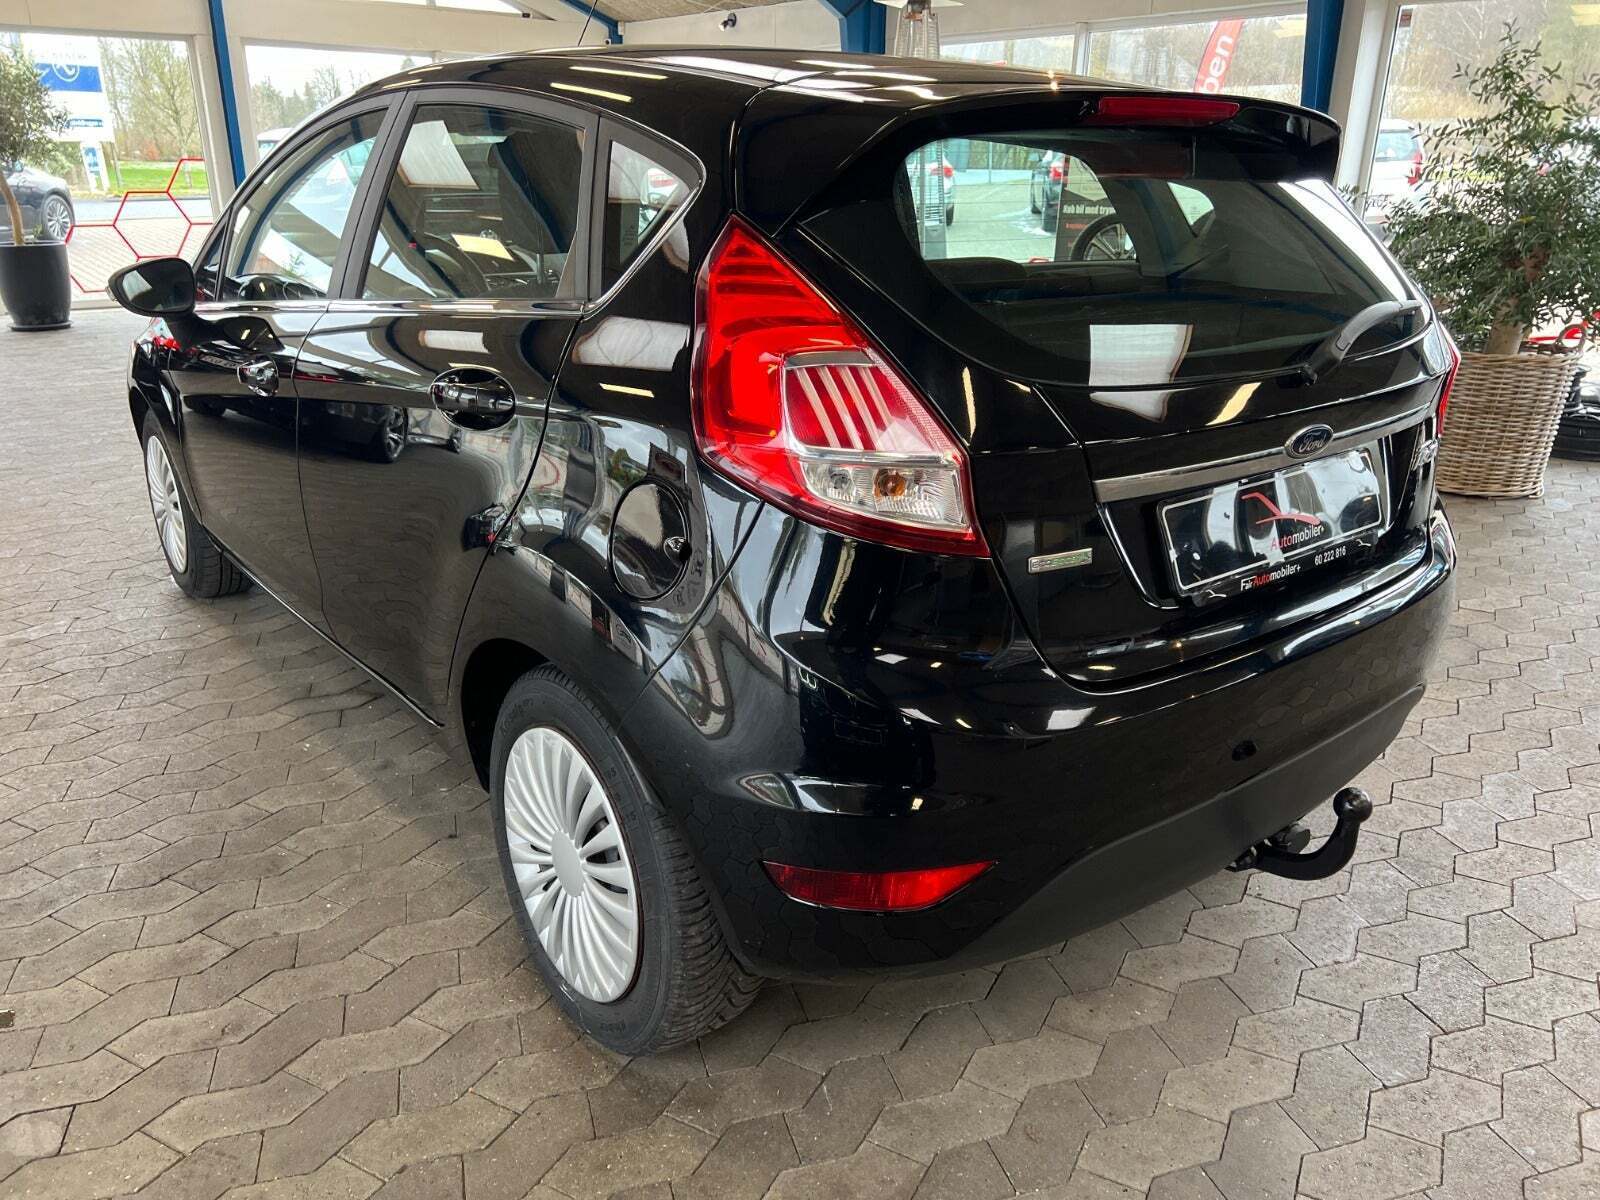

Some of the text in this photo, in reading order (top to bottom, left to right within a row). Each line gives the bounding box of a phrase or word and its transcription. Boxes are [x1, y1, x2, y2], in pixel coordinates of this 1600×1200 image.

[1298, 430, 1328, 452] Ford
[1314, 555, 1323, 566] 60
[1323, 550, 1334, 563] 222
